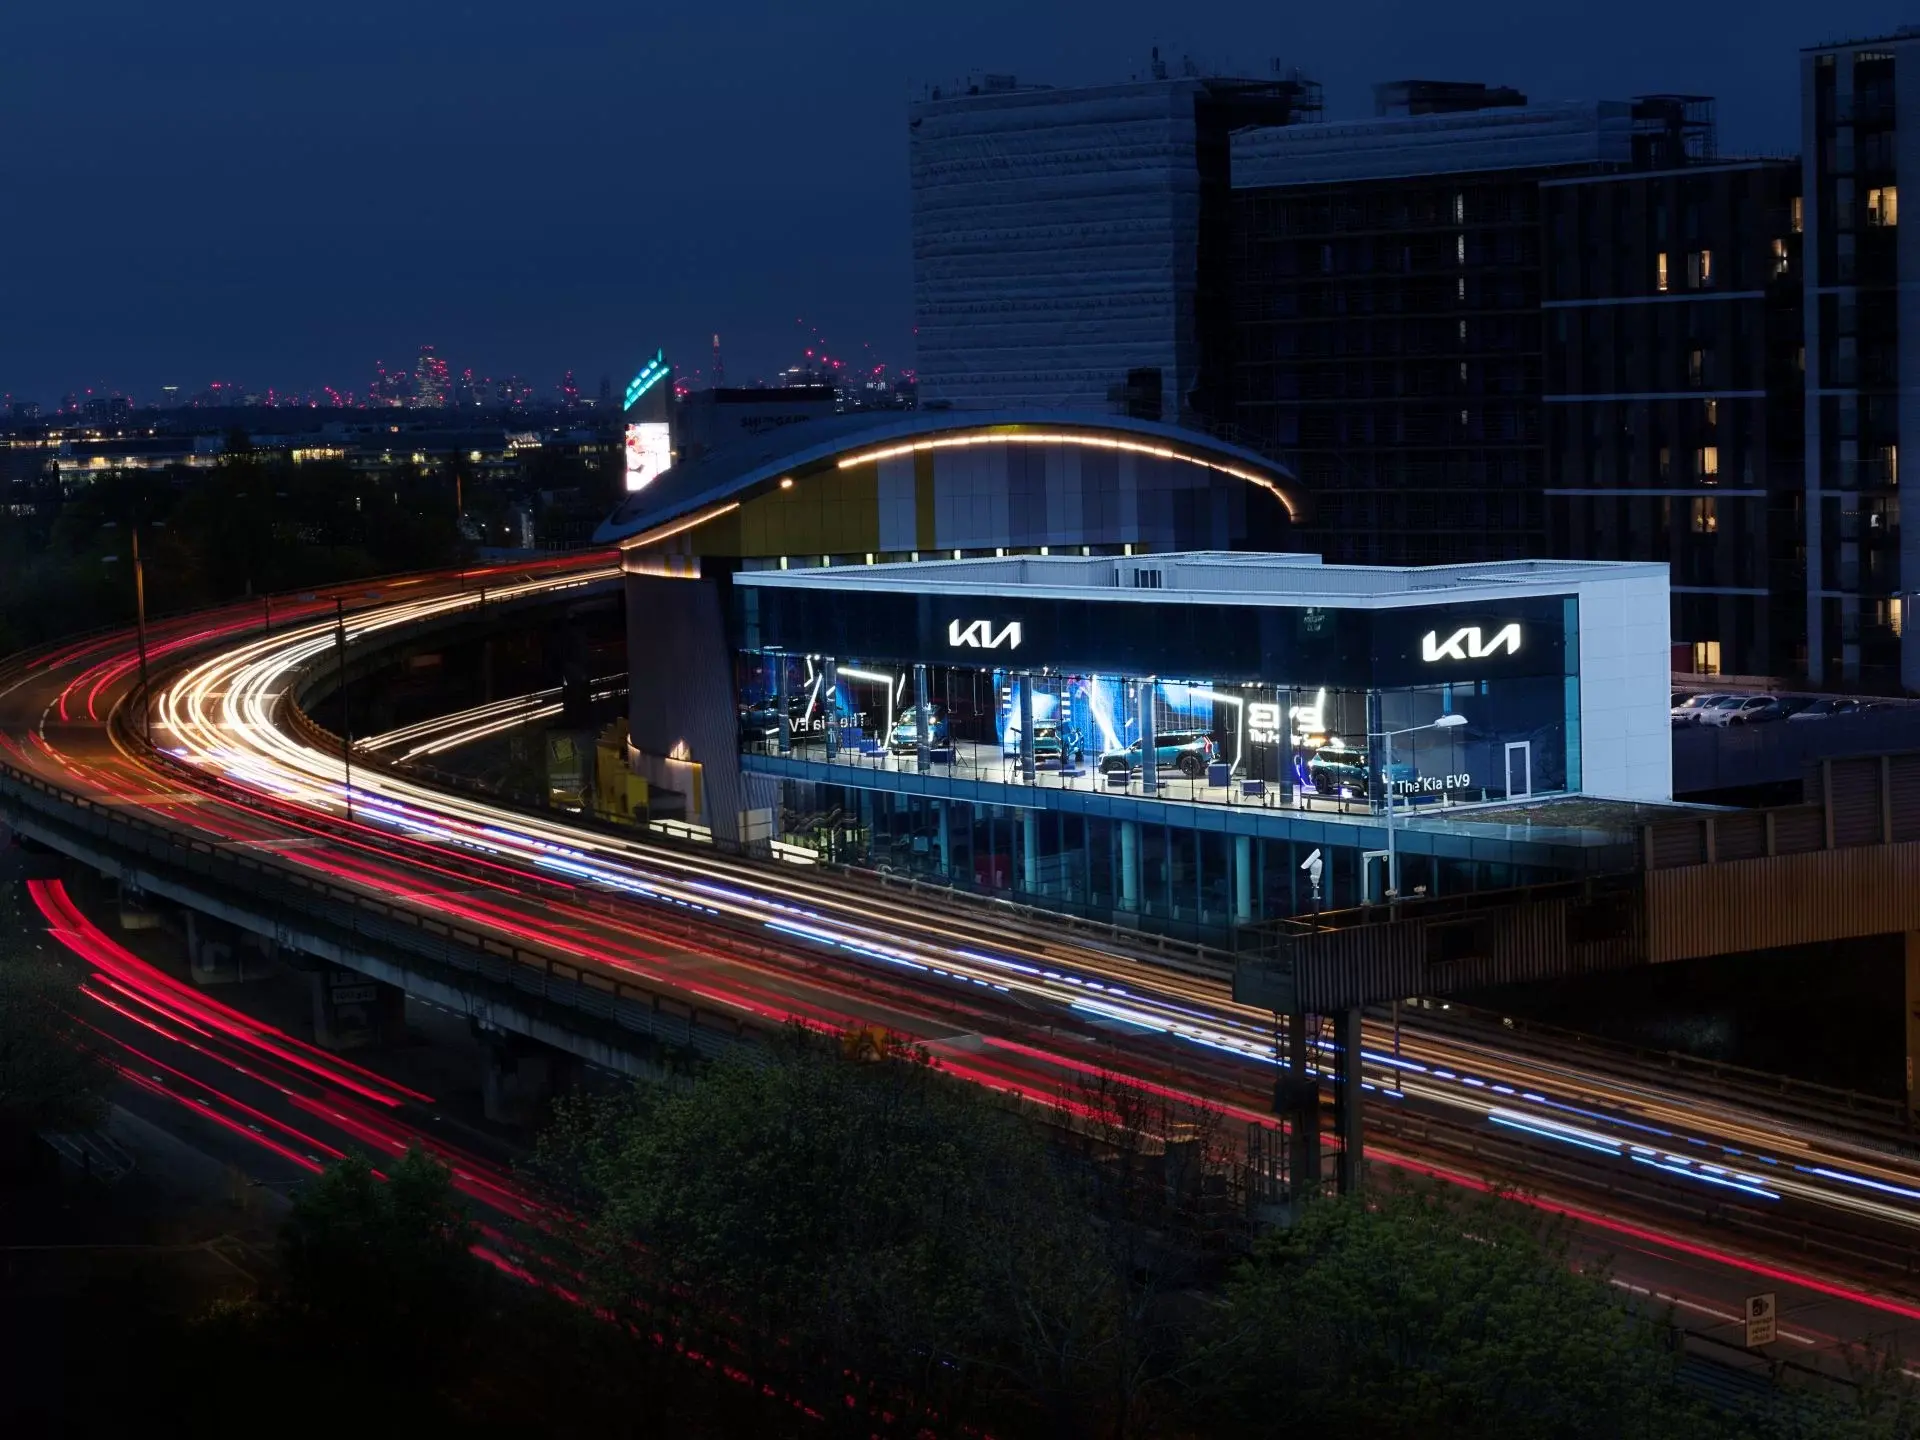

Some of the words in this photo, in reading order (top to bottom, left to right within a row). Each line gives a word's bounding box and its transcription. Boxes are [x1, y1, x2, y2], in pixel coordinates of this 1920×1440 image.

[949, 618, 1022, 650] KIA
[1422, 623, 1521, 662] KIA
[1397, 780, 1420, 794] The
[1423, 777, 1443, 791] Kia
[1446, 773, 1470, 789] EV9
